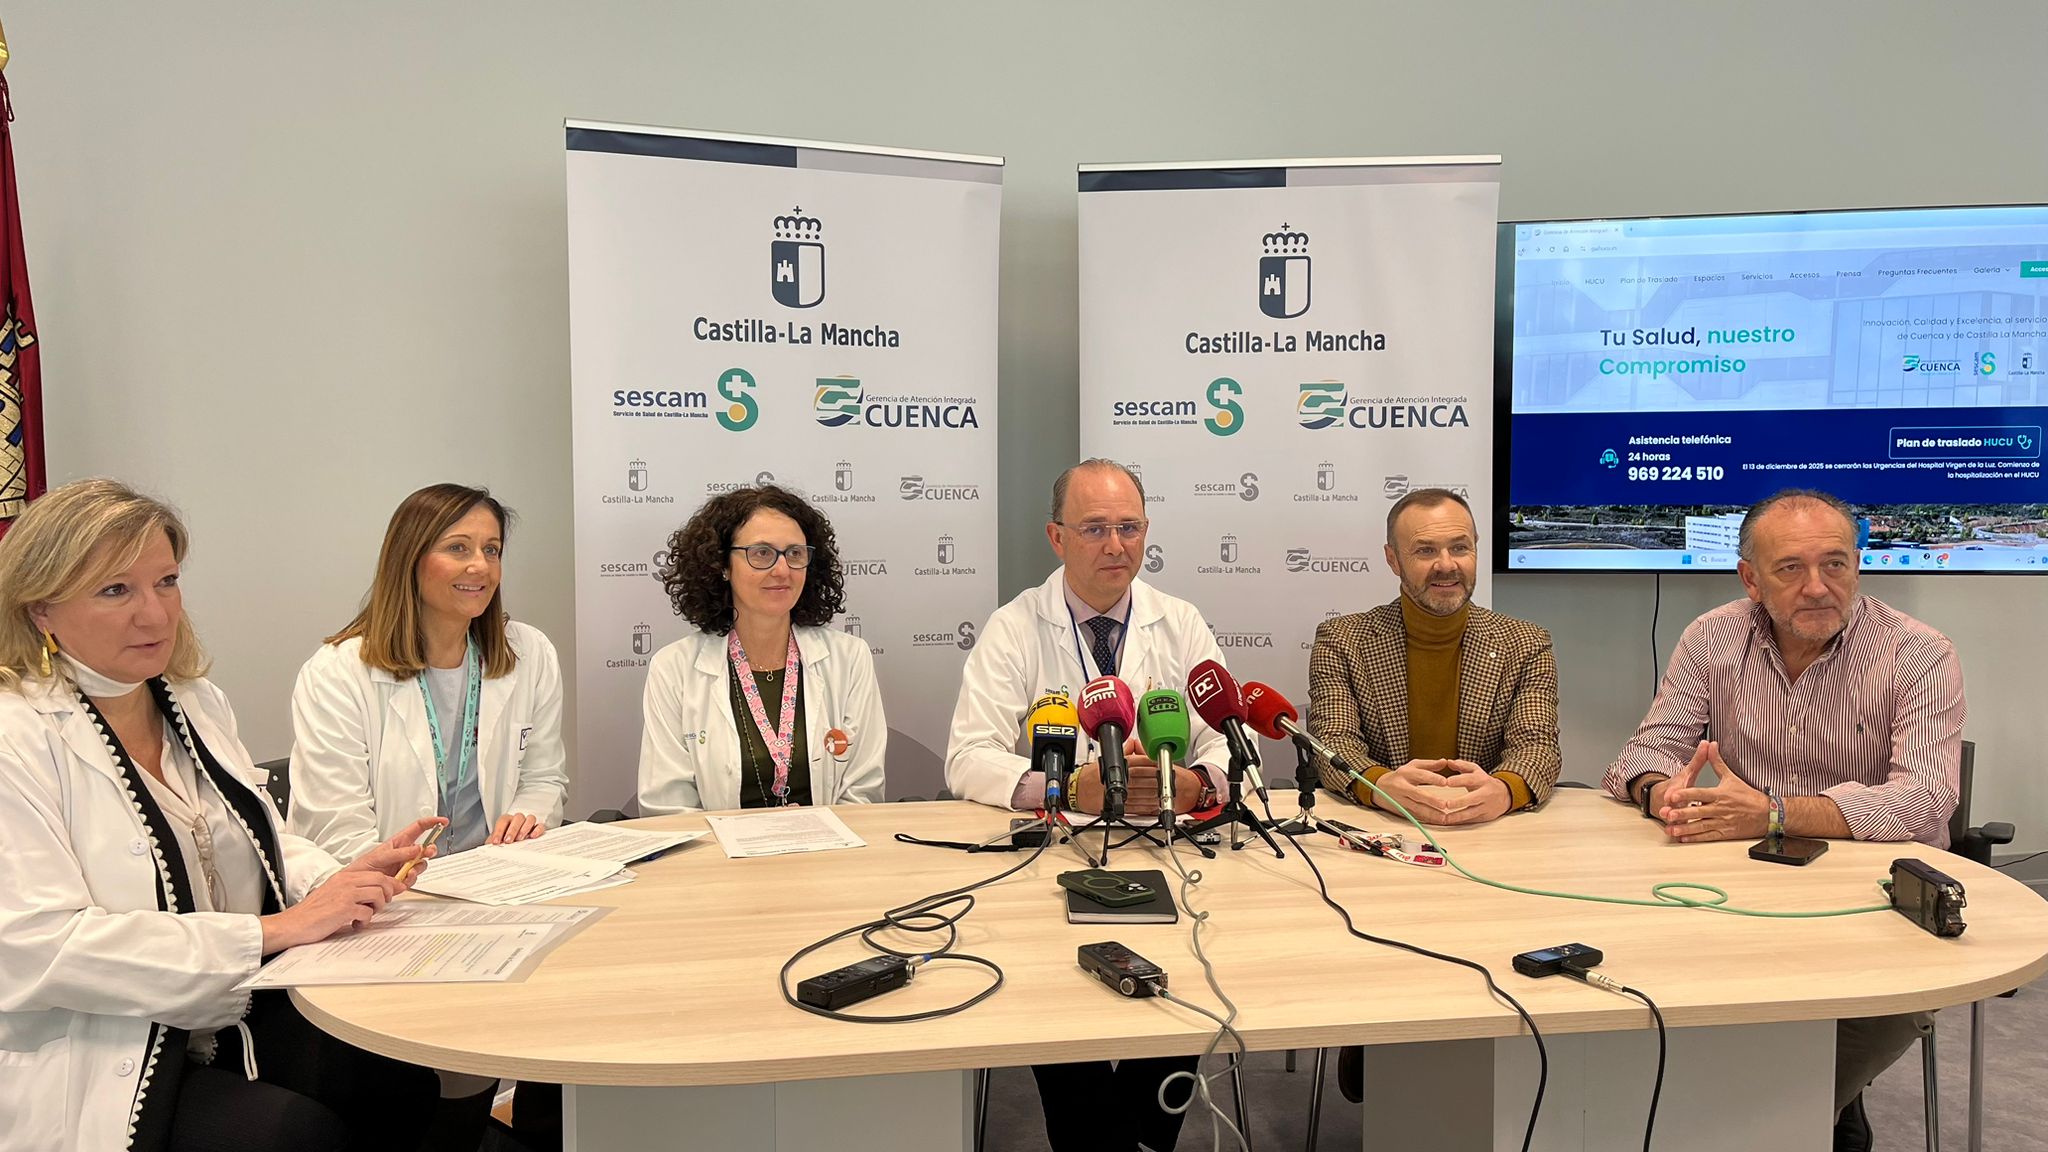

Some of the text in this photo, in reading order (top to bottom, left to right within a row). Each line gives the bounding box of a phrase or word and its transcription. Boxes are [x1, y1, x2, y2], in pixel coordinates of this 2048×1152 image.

[1878, 269, 1915, 277] Preguntas
[694, 316, 899, 347] Castilla-La Mancha
[1600, 326, 1795, 347] Tu Salud, nuestro
[1186, 330, 1385, 353] Castilla-La Mancha
[1600, 355, 1746, 379] Compromiso
[1920, 363, 1960, 372] CUENCA
[613, 390, 707, 408] sescam
[944, 396, 976, 405] Integrada
[1432, 396, 1467, 404] Integrada
[1114, 401, 1196, 416] sescam
[865, 405, 978, 428] CUENCA
[1349, 405, 1469, 428] CUENCA
[1629, 435, 1732, 444] Asistencia telefónica
[1896, 438, 2013, 448] Plan de traslado HUCU
[1628, 452, 1670, 461] 24 horas
[1628, 466, 1724, 480] 969 224 510
[1955, 472, 2002, 480] hospitalización
[1195, 483, 1236, 492] sescam
[602, 495, 643, 503] Castilla-La
[812, 494, 848, 502] Castilla-La
[925, 489, 979, 500] CUENCA
[601, 563, 647, 572] sescam
[843, 563, 887, 576] UENCA
[1311, 561, 1369, 572] CUENCA
[913, 633, 954, 642] sescam
[1216, 636, 1272, 647] CUENCA
[606, 659, 647, 668] Castilla-La
[1036, 725, 1075, 735] SER
